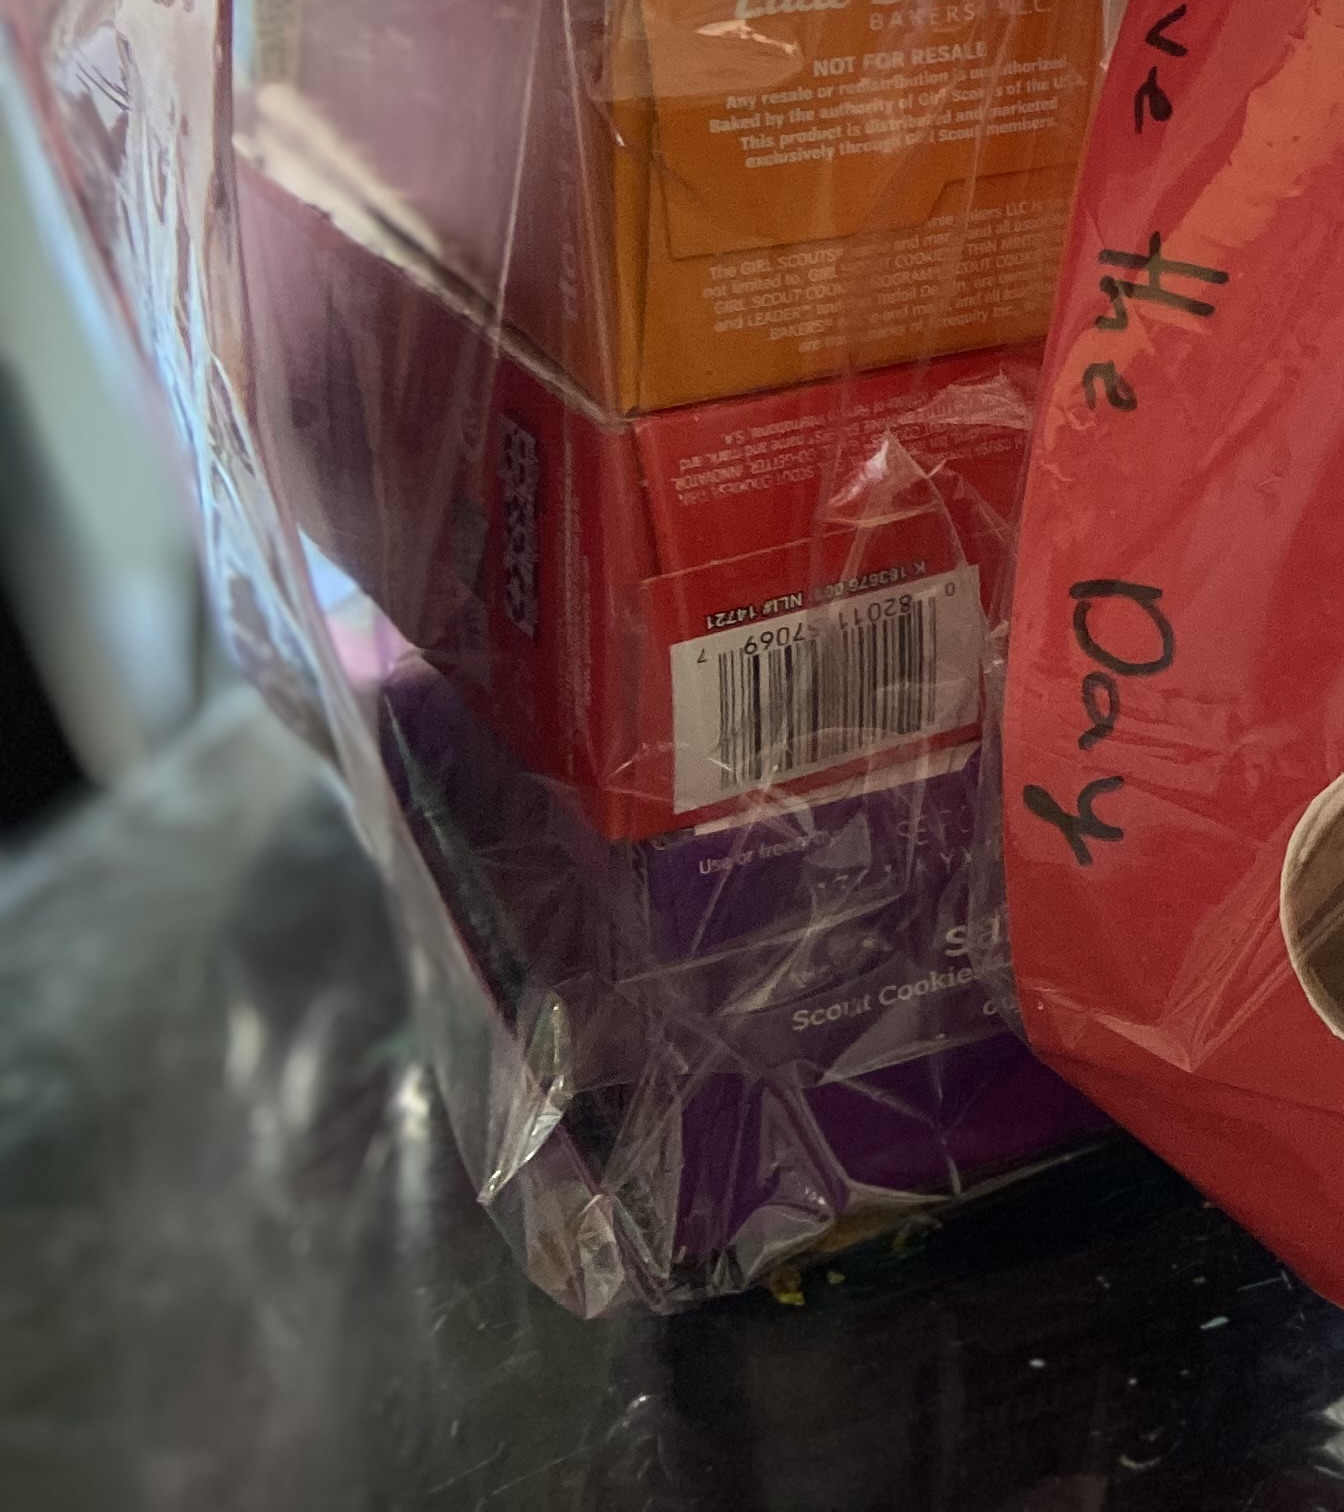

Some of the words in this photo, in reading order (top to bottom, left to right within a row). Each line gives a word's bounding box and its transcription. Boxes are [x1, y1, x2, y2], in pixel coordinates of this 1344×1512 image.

[812, 55, 856, 79] NOT
[861, 49, 906, 72] FOR
[910, 40, 988, 66] RESALE
[764, 109, 785, 129] by
[787, 105, 816, 123] the
[942, 581, 957, 597] 0
[706, 605, 758, 629] 14721
[837, 593, 915, 623] 82011
[693, 648, 708, 664] 7
[1022, 577, 1178, 868] Day
[791, 993, 874, 1032] Scout
